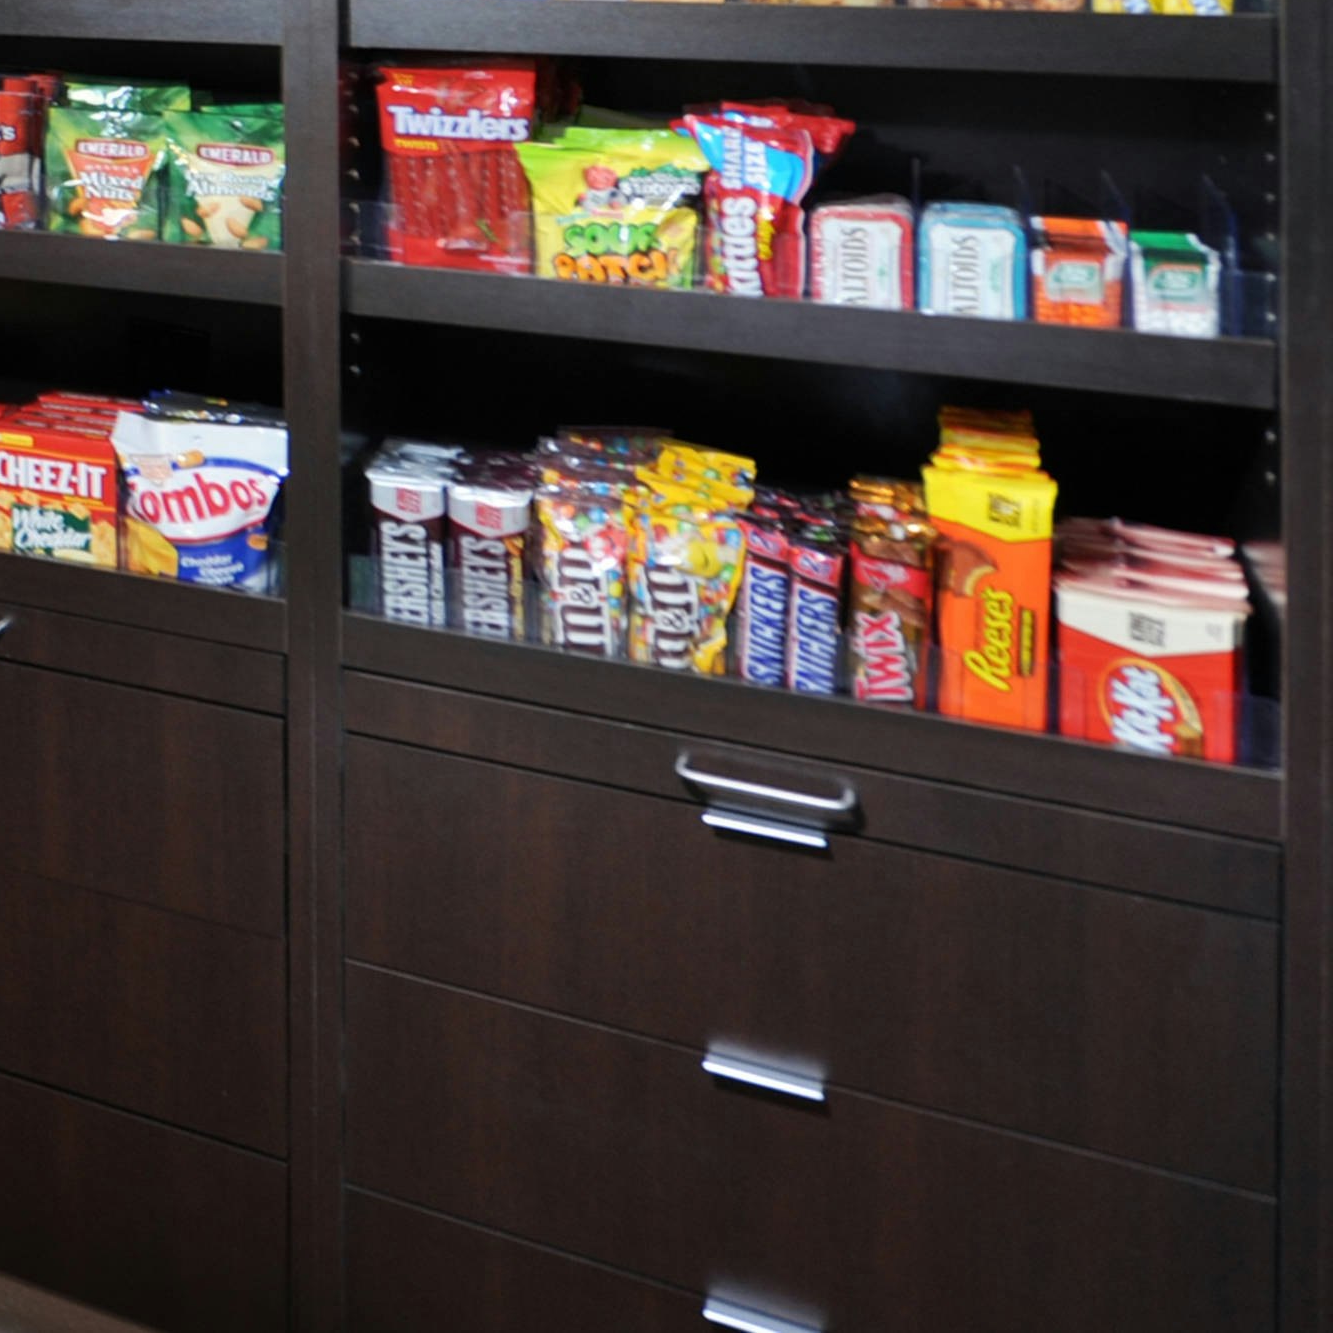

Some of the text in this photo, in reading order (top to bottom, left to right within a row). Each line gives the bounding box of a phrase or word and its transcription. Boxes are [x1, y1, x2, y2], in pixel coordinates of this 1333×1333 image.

[386, 104, 530, 142] Twizzlers
[77, 142, 148, 158] EMERALD
[199, 146, 273, 164] EMERALD
[720, 126, 742, 190] SHARE
[743, 140, 768, 187] SIZE
[80, 170, 145, 189] Mixed
[85, 185, 136, 199] Nuts
[564, 222, 661, 257] SOUR
[720, 196, 764, 298] kittles
[131, 472, 268, 524] ombos
[379, 521, 430, 627] ERSHEY'S
[459, 535, 510, 639] ERSHEY'S
[747, 567, 787, 686] SNICKERS
[962, 585, 1015, 692] Reese's
